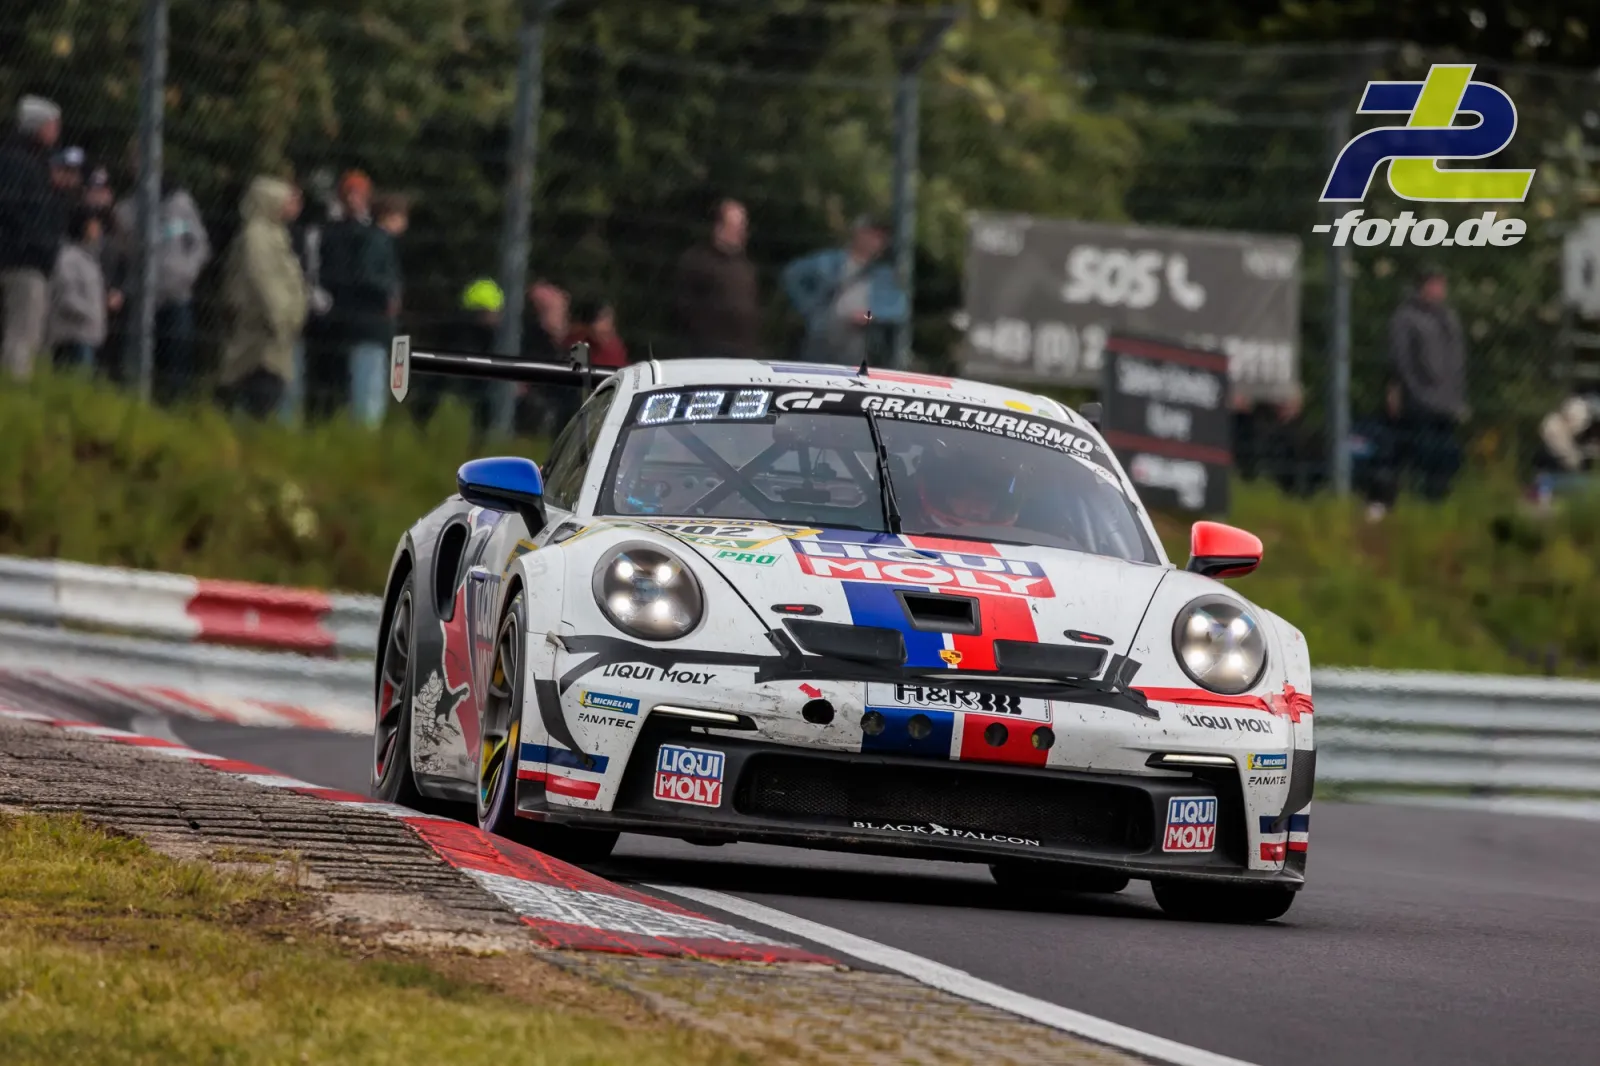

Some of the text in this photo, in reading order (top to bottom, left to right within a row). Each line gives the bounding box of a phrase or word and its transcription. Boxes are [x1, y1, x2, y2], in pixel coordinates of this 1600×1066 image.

[1063, 244, 1163, 308] SOS
[749, 377, 845, 388] BLACK
[640, 389, 772, 423] 023
[860, 396, 1093, 454] GRAN TURISMO
[864, 411, 1092, 461] HE REAL DRIVING SIMULATOR
[717, 550, 776, 565] PRO
[800, 540, 1033, 576] LIQUI
[809, 556, 1045, 595] MOLY
[603, 664, 717, 685] LIQUI MOLY
[592, 696, 633, 710] MICHELIN
[895, 683, 978, 709] H&R
[578, 713, 636, 729] FANATEC
[1186, 714, 1274, 734] LIQUI MOLY
[660, 747, 723, 778] LIQUI
[658, 778, 722, 804] MOLY
[1248, 776, 1287, 785] FANATEC
[1170, 801, 1215, 824] LIQUI
[853, 821, 1040, 846] BLACK FALCON
[1167, 826, 1215, 848] MOLY
